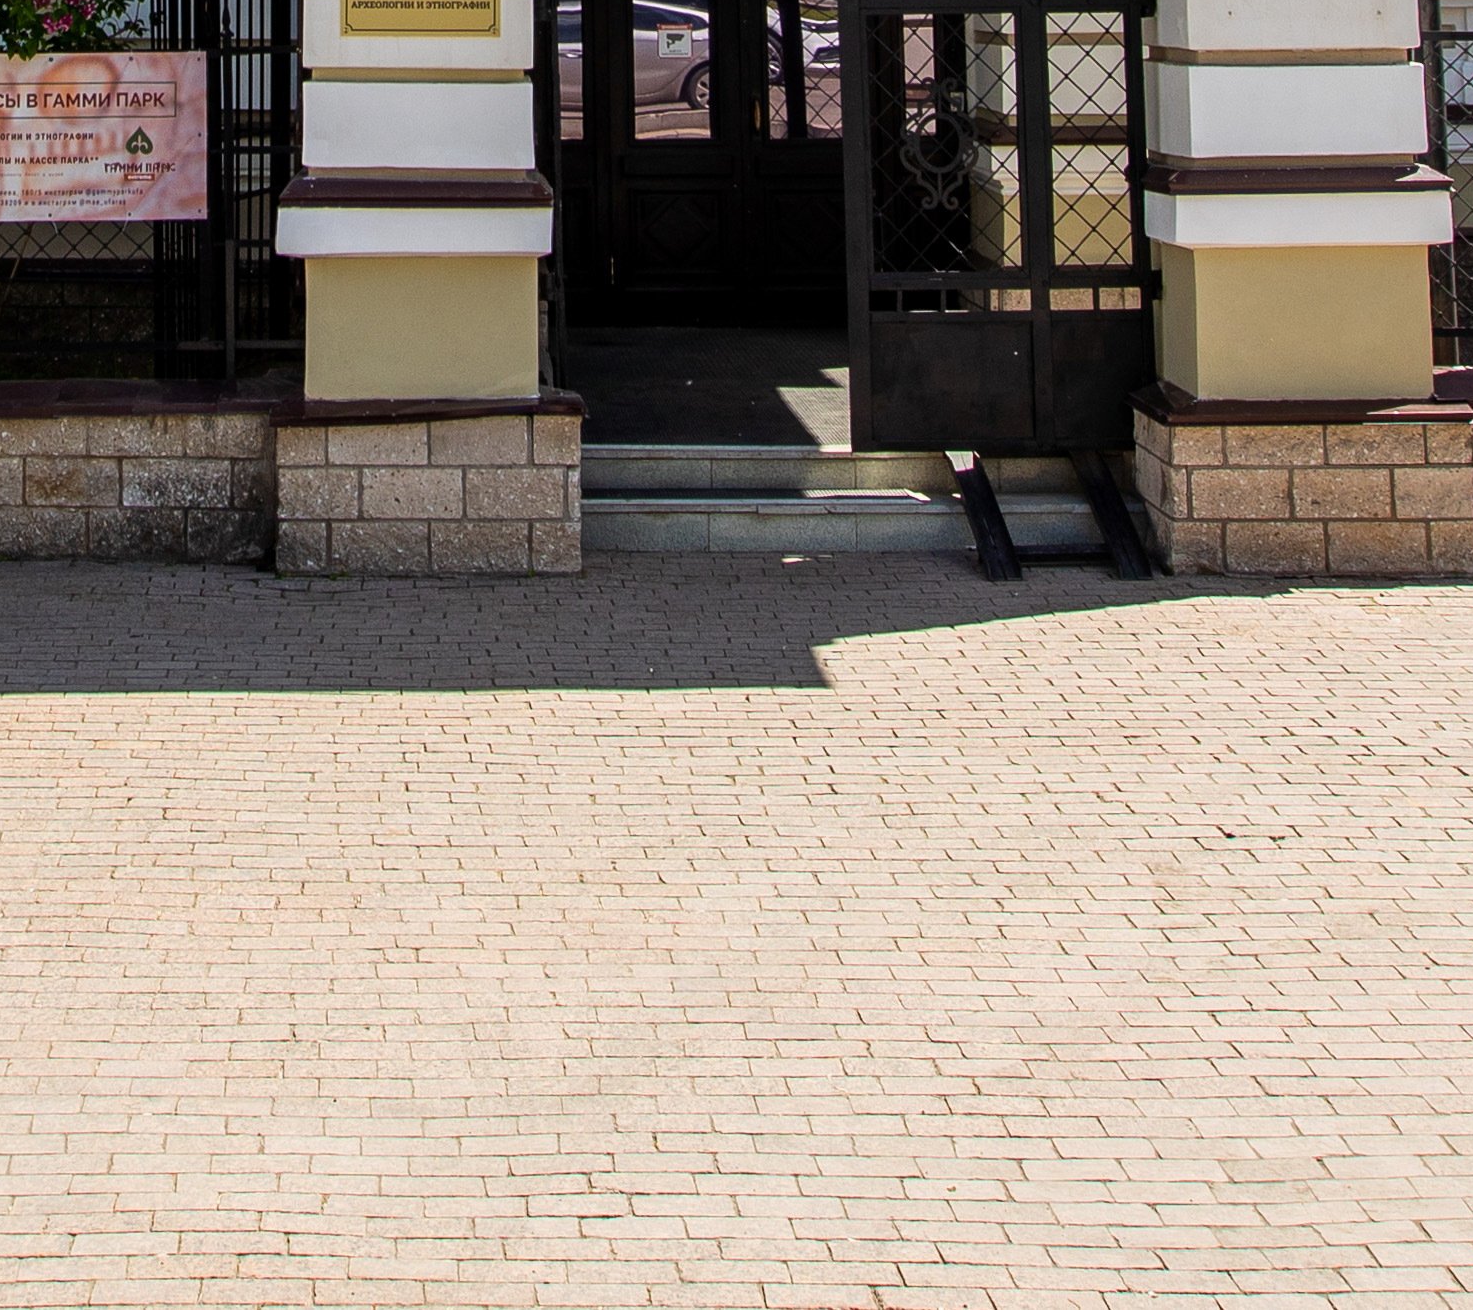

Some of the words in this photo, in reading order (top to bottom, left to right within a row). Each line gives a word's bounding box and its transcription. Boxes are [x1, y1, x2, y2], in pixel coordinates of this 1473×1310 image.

[351, 1, 414, 10] АРХЕОЛОГИИ
[416, 1, 424, 10] И
[426, 1, 490, 10] ЭТНОГРАФИИ
[27, 94, 38, 108] В
[43, 93, 111, 108] ГАММИ
[116, 92, 165, 107] ПАРК
[26, 133, 32, 141] И
[35, 133, 94, 141] ЭТНОГРАФИИ
[104, 162, 142, 173] ГАММИ
[145, 162, 176, 173] ПАРК
